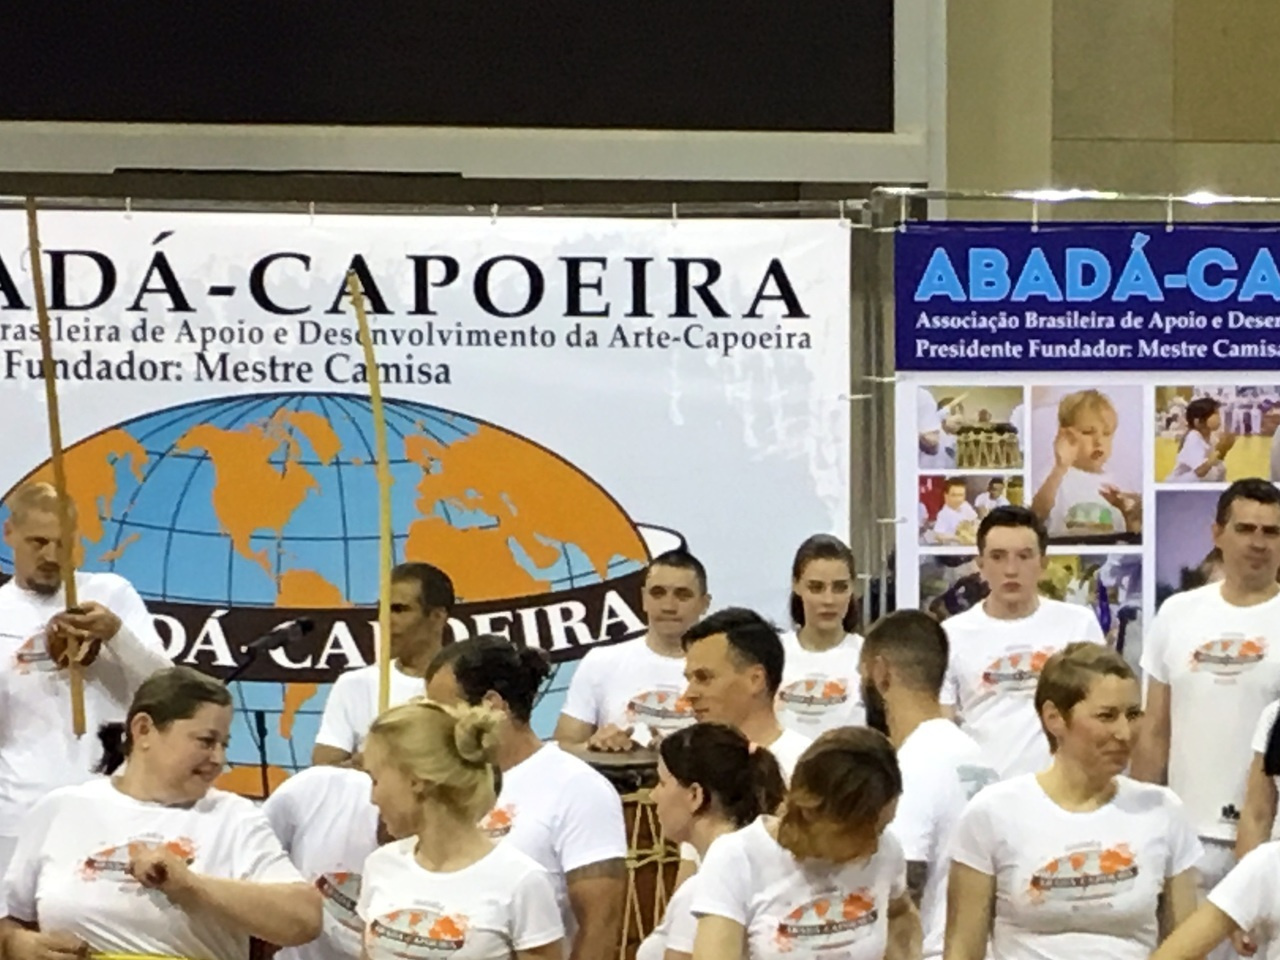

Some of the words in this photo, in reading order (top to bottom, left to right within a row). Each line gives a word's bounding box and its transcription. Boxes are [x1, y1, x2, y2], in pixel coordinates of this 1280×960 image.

[915, 311, 1020, 333] Associação
[1024, 311, 1115, 329] Brasileira
[1120, 311, 1144, 329] de
[1148, 311, 1208, 333] Apoio
[1211, 316, 1223, 329] e
[0, 317, 121, 342] rasleira
[131, 317, 165, 343] de
[175, 318, 264, 352] Apoio
[273, 325, 288, 345] e
[565, 321, 599, 348] da
[608, 323, 812, 356] Arte-Capoeira
[915, 339, 1023, 358] Presidente
[1028, 339, 1132, 358] Fundador:
[1137, 339, 1208, 358] Mestre
[4, 349, 182, 382] Fundador:
[194, 351, 313, 383] Mestre
[324, 352, 452, 384] Camisa
